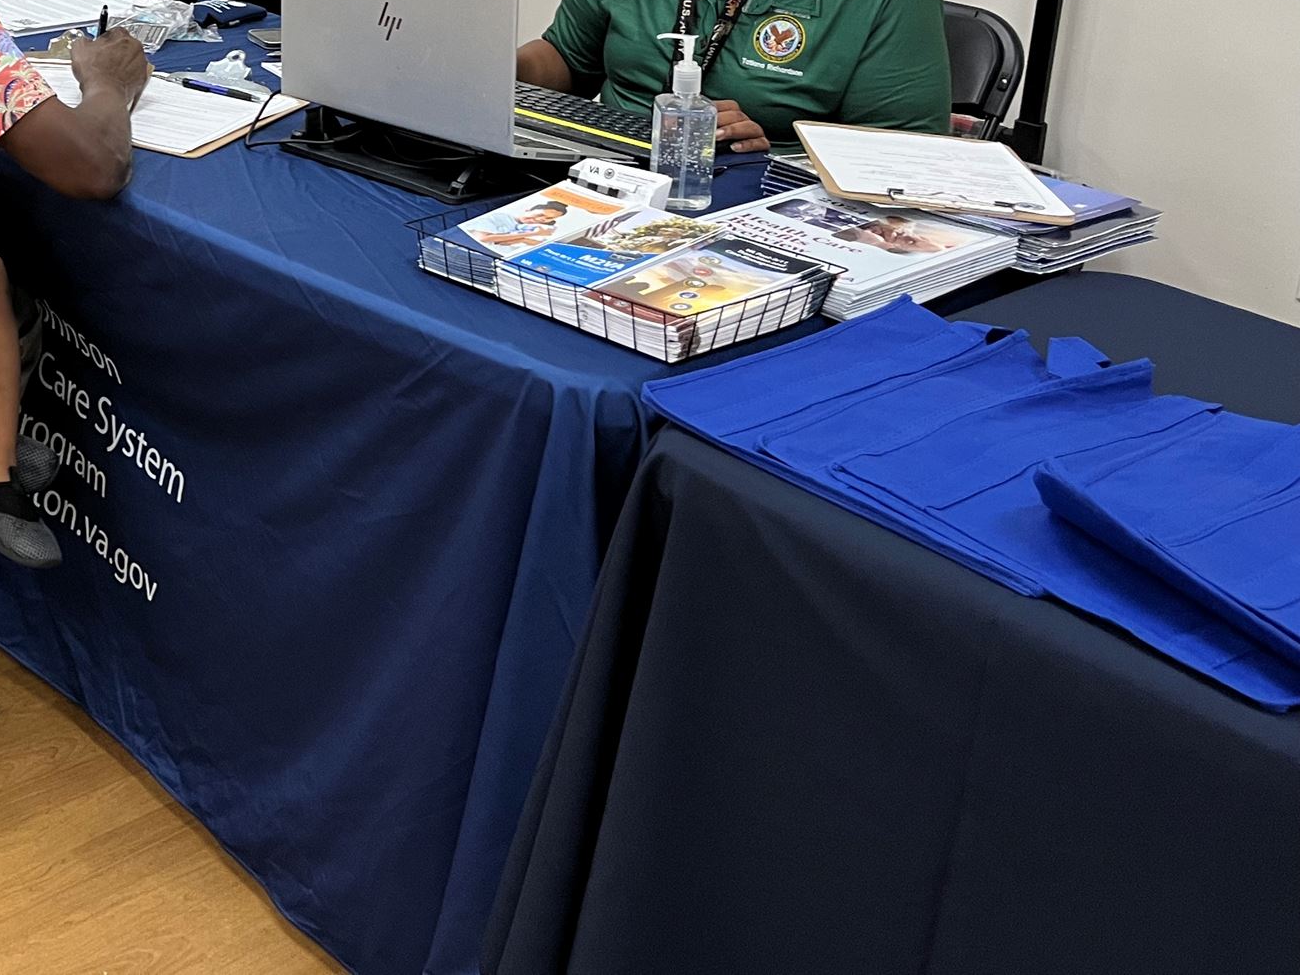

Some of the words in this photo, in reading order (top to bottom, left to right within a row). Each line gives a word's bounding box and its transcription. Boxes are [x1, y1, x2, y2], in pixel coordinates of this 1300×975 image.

[741, 213, 808, 237] Health
[812, 237, 862, 253] Care
[19, 406, 106, 499] rogram
[38, 351, 90, 420] Care
[94, 396, 186, 503] System
